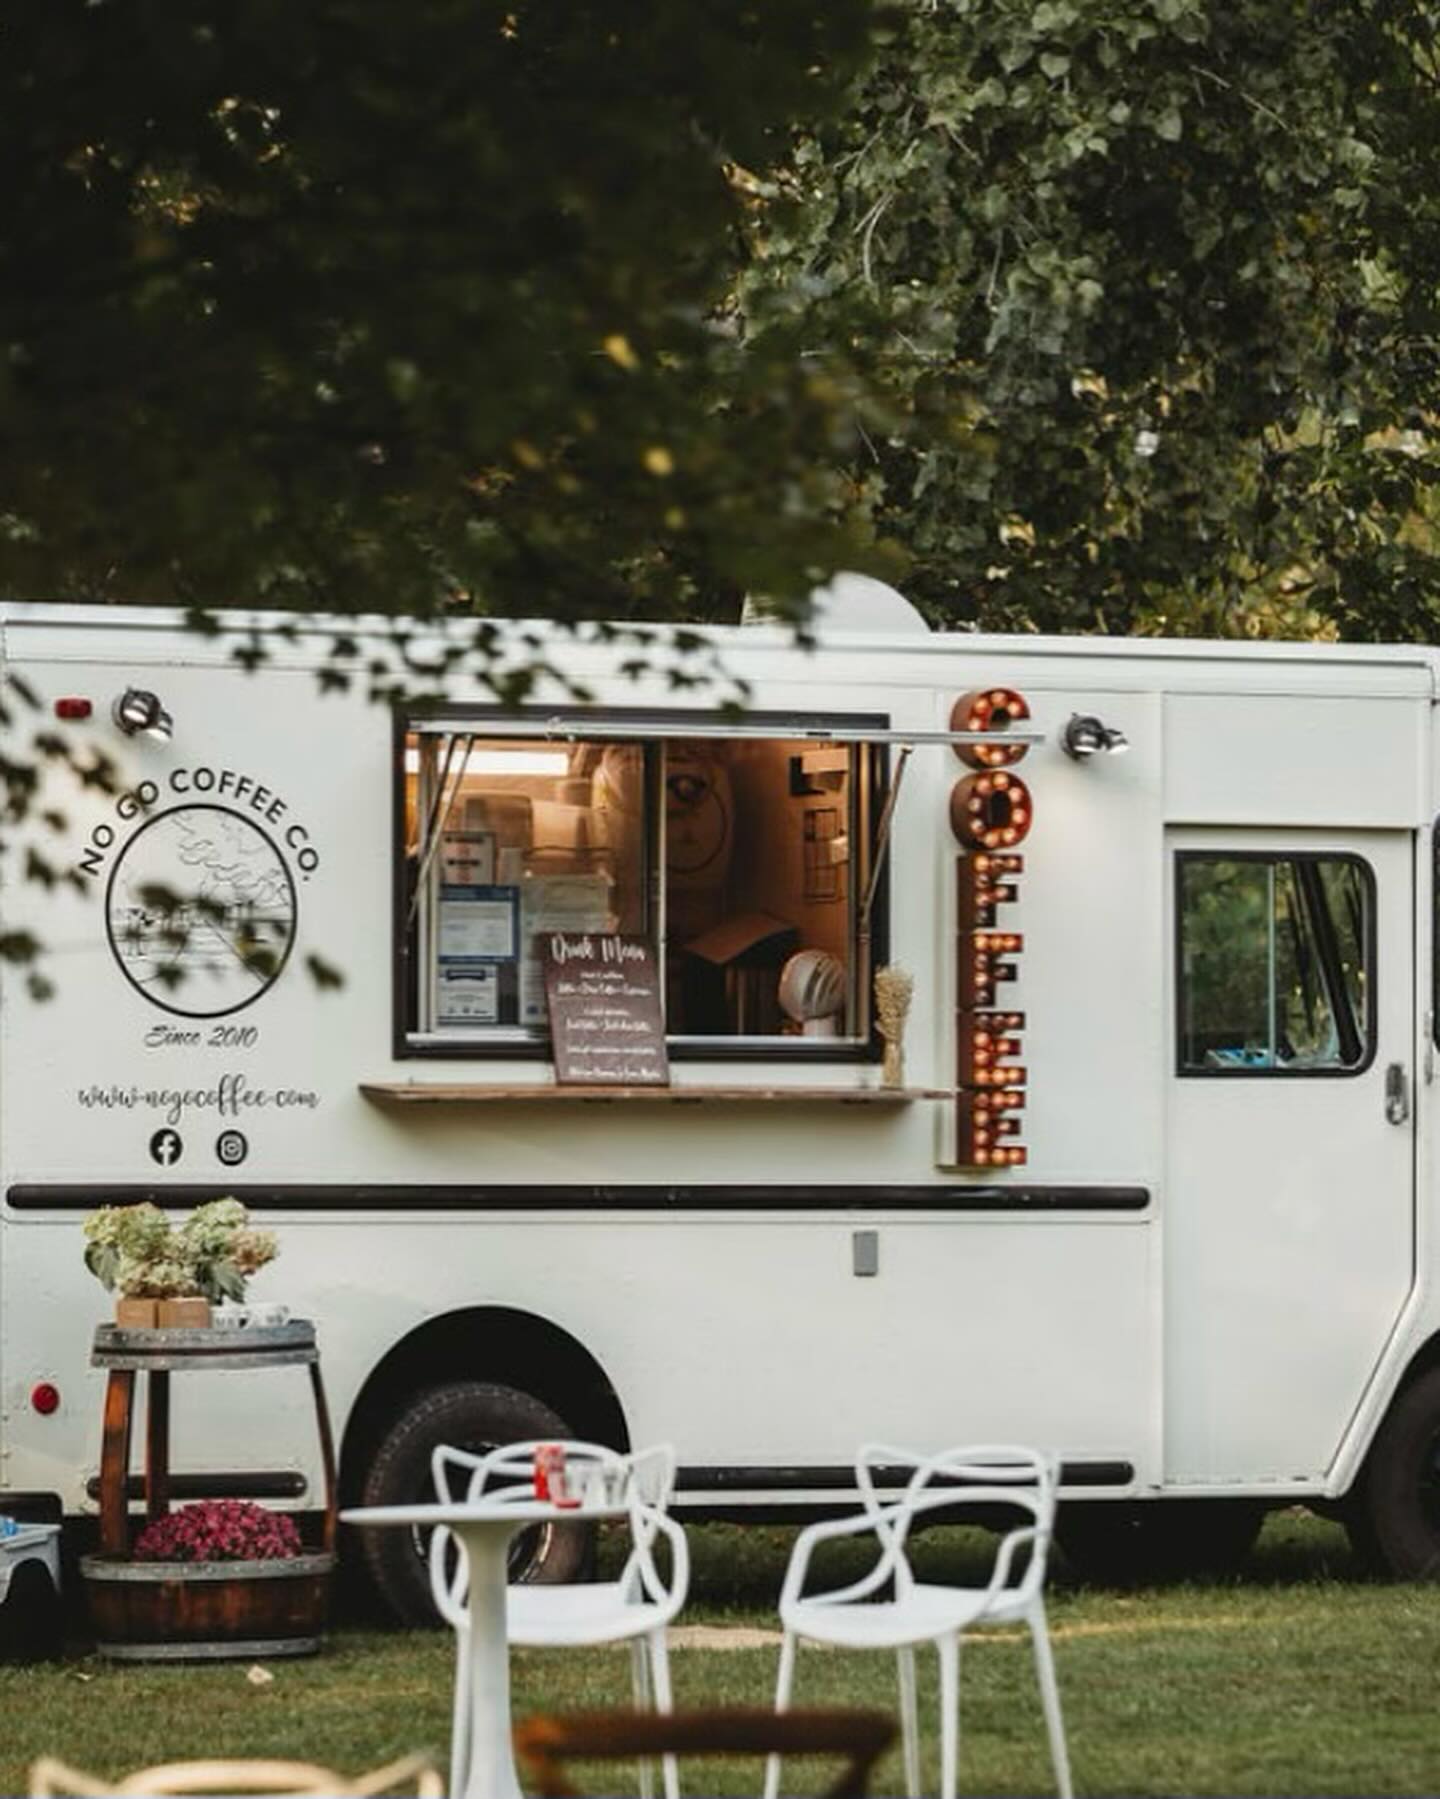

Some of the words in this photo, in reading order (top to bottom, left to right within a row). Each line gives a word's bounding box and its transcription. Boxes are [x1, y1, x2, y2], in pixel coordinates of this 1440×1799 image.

[79, 824, 115, 876] NO
[116, 780, 160, 820] GO
[169, 767, 288, 825] COFFEE
[285, 824, 319, 882] CO.
[949, 687, 1032, 1168] COFFEE
[144, 1025, 200, 1048] Since
[207, 1026, 259, 1048] 2010
